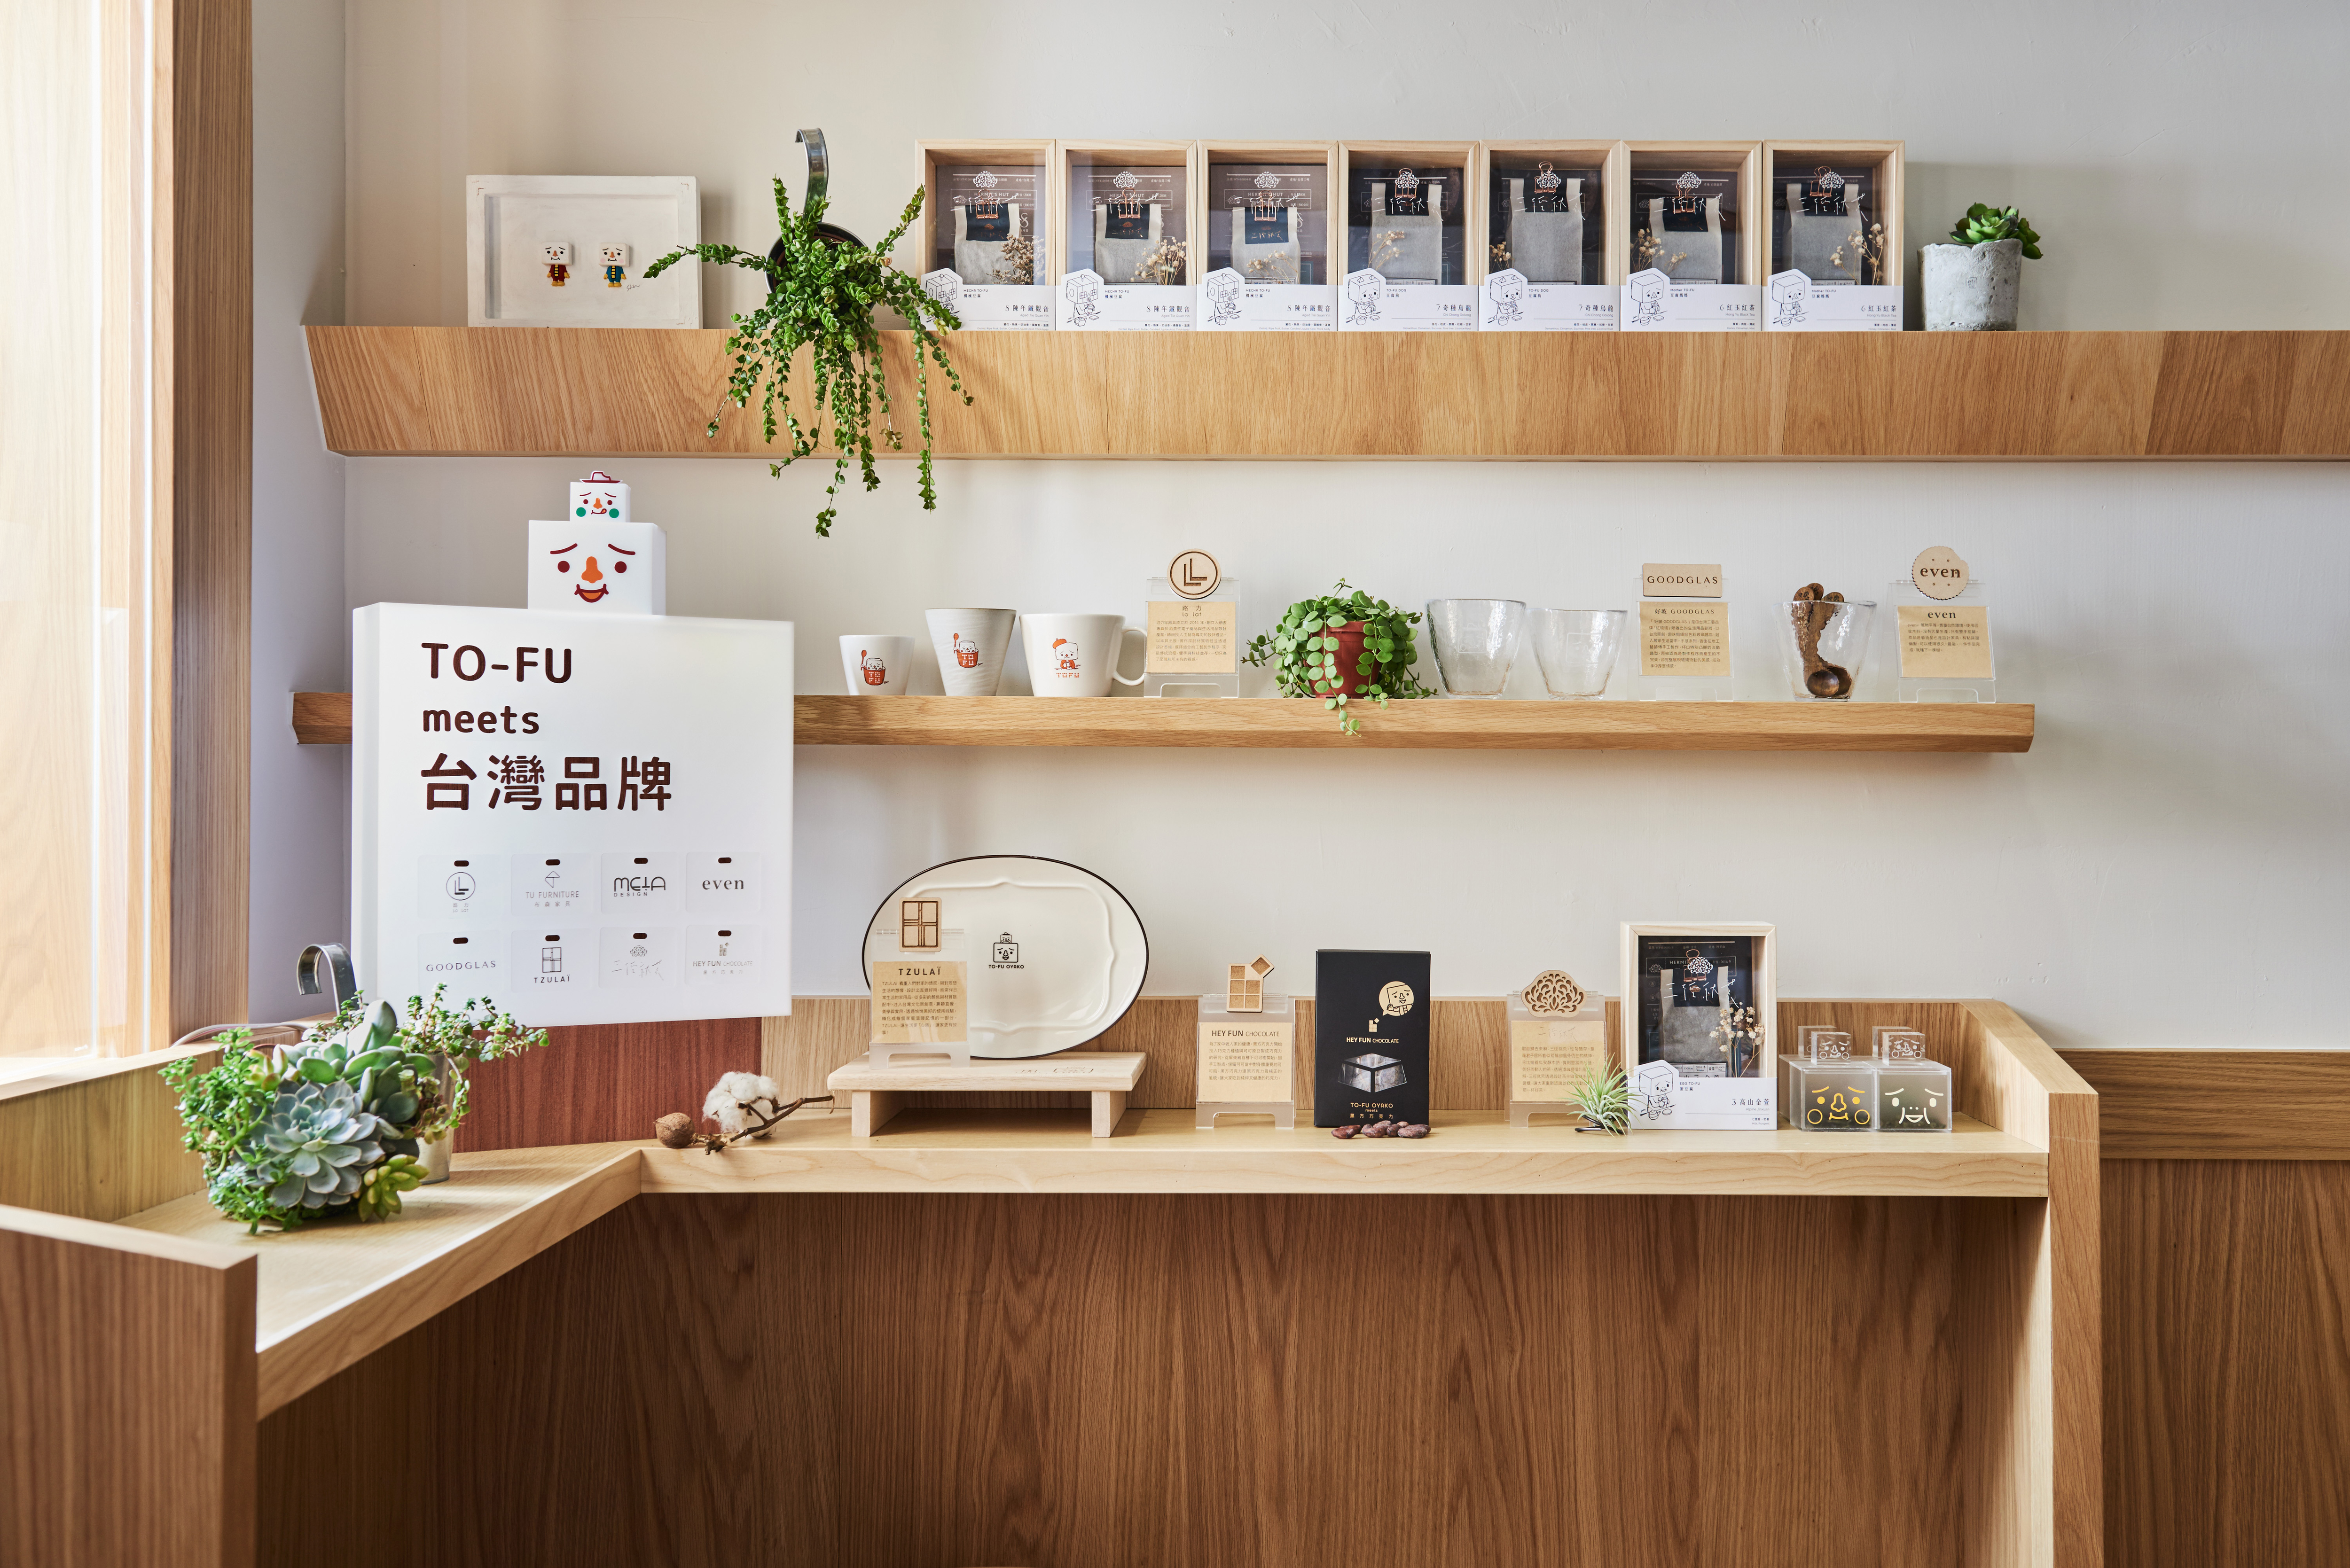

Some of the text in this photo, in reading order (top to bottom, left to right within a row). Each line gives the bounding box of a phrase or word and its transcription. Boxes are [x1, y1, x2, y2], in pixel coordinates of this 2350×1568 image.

[1920, 568, 1961, 578] even
[421, 642, 572, 683] TO-FU
[423, 706, 540, 733] meets
[421, 753, 672, 811] 台灣品牌
[702, 879, 744, 890] even
[426, 960, 496, 972] GOODGLAS
